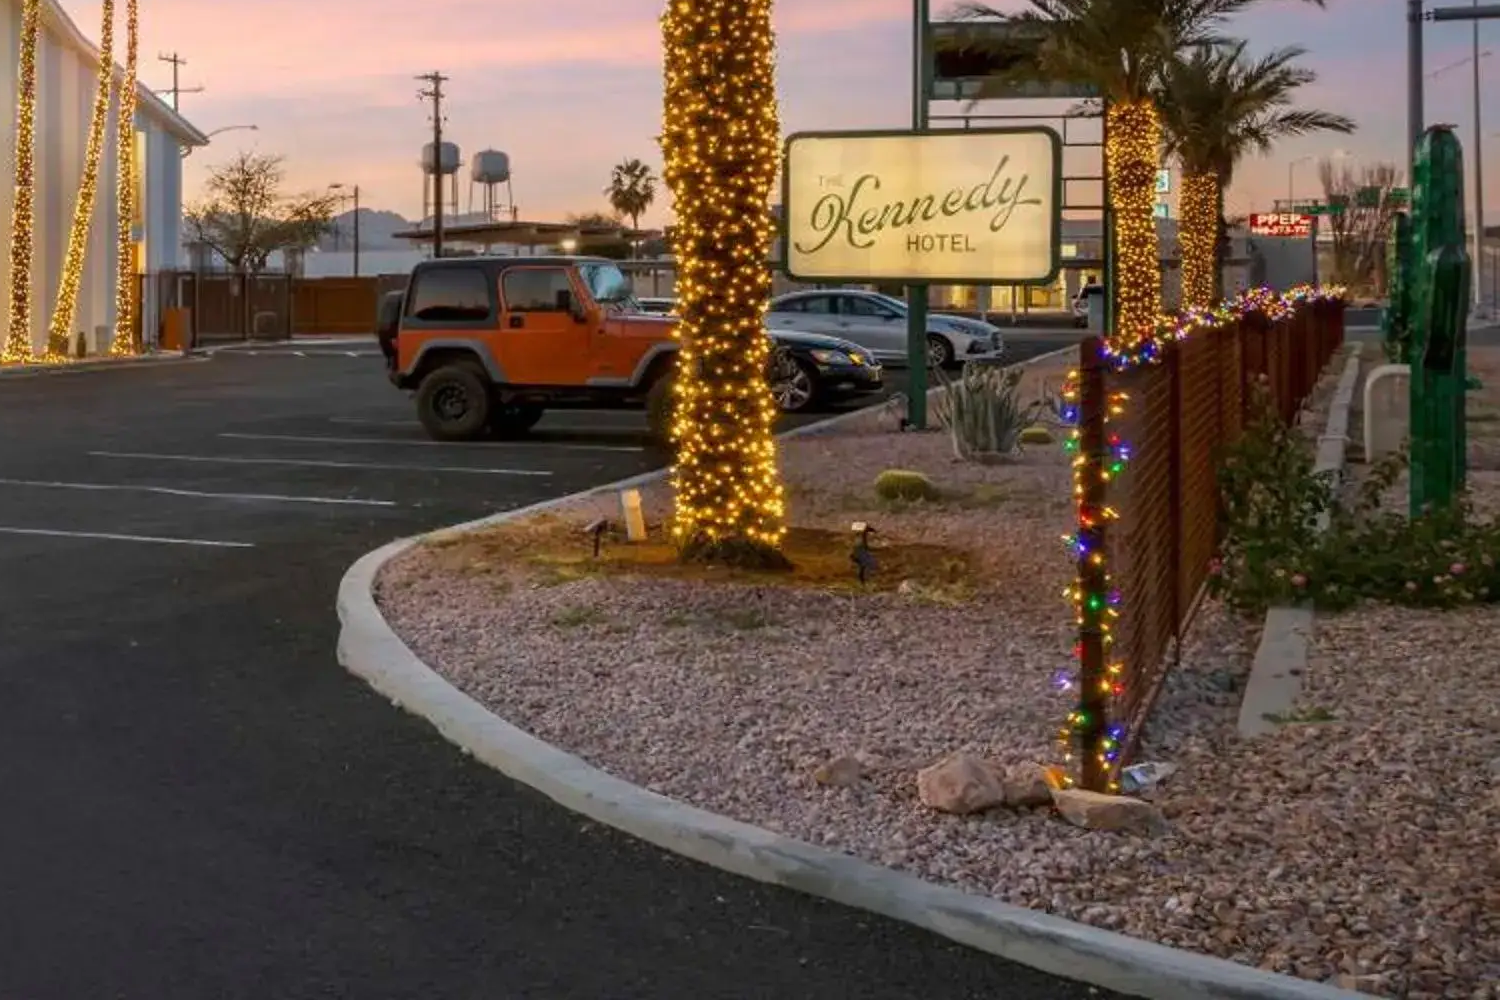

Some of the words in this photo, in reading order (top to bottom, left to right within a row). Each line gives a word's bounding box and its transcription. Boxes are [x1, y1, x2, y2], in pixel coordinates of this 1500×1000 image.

[818, 174, 845, 188] THE
[794, 154, 1043, 254] Kennedy
[906, 234, 977, 253] HOTEL
